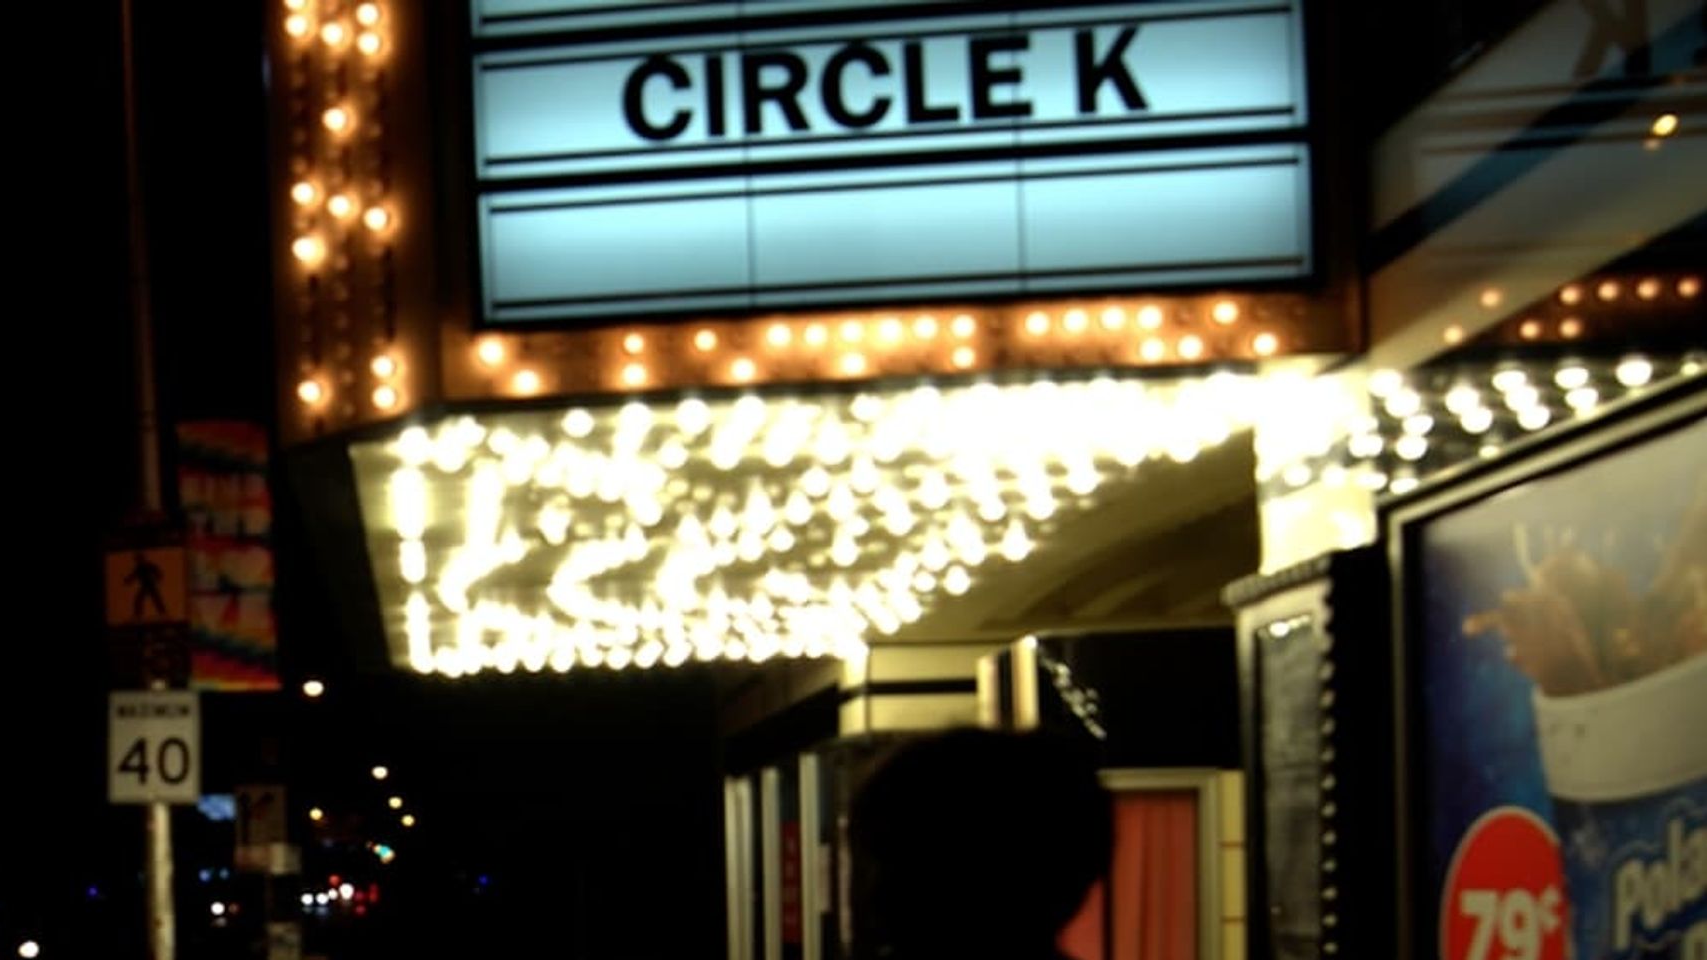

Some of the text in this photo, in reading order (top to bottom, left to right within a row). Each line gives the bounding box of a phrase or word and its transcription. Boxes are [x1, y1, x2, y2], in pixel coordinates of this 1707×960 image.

[622, 25, 1149, 143] CIRCLE K
[117, 736, 190, 786] 40
